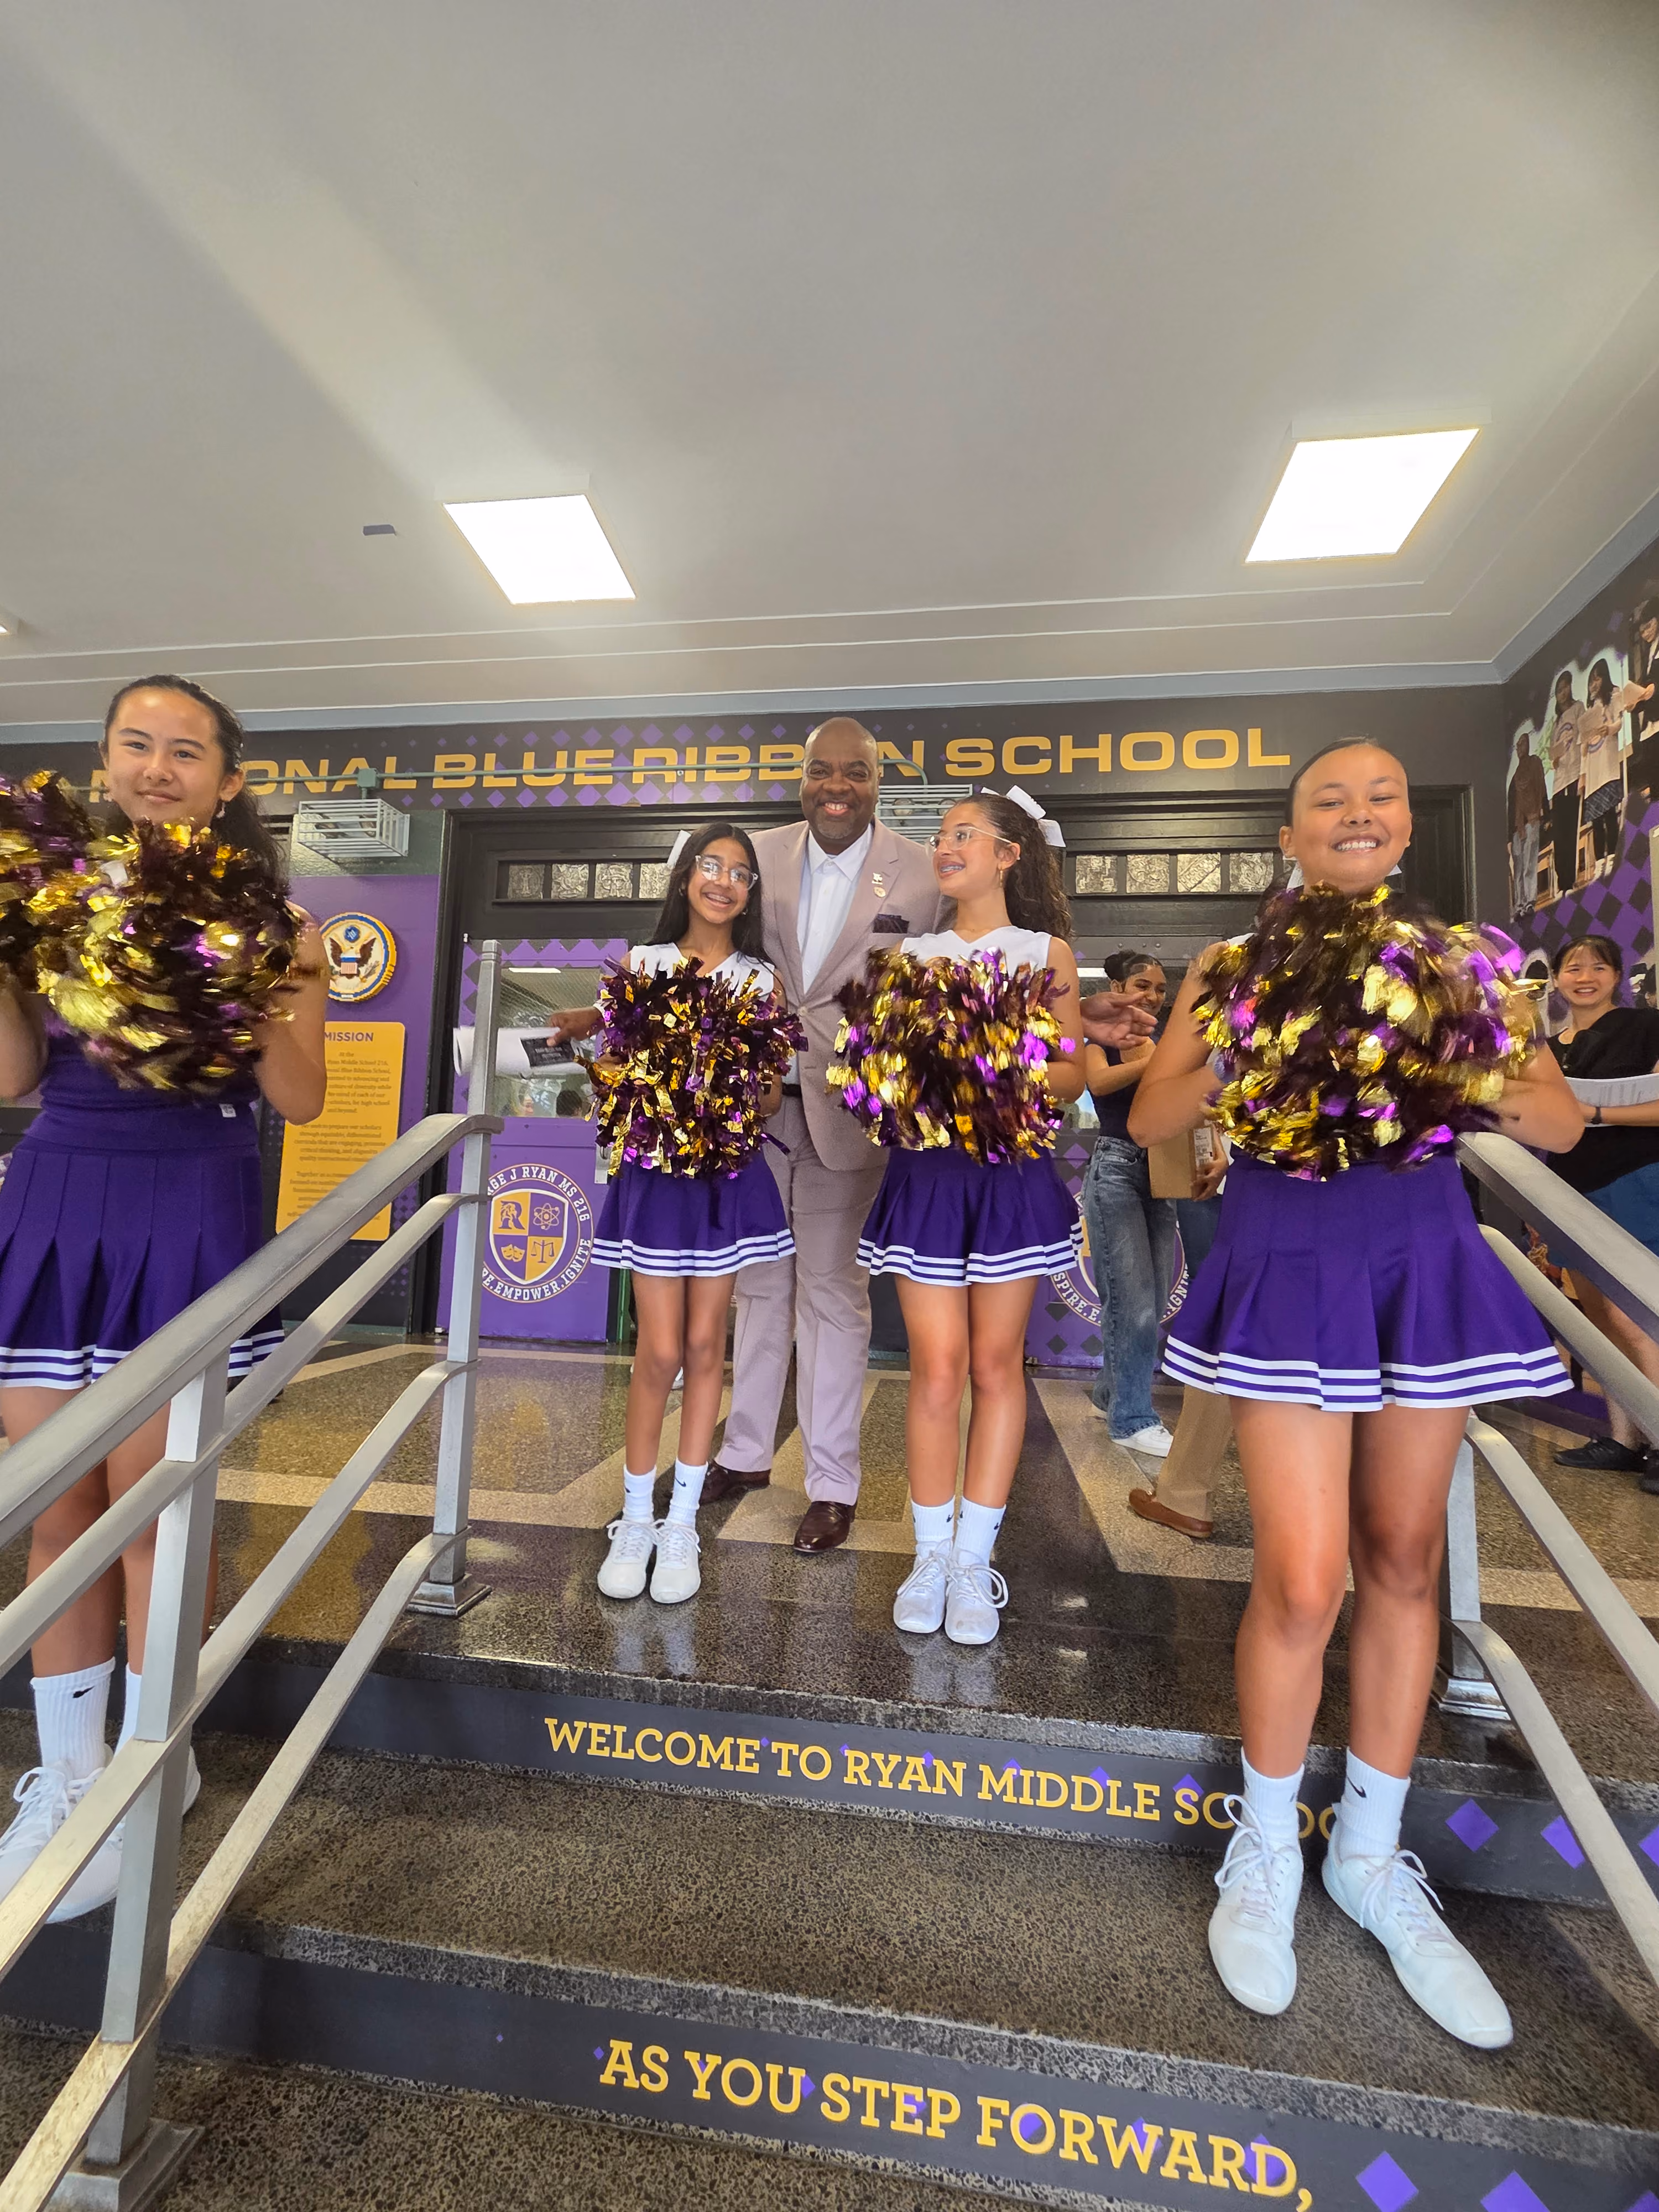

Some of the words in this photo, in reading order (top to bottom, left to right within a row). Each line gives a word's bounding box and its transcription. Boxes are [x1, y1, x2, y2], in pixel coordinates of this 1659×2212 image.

[88, 756, 416, 803] ONAL
[432, 749, 614, 789] BLUE
[632, 740, 924, 784] RIBBN
[945, 728, 1291, 777] SCHOOL
[324, 1032, 374, 1042] MISSION
[510, 1168, 517, 1180] J
[522, 1166, 558, 1183] RYAN
[558, 1178, 577, 1197] MS
[573, 1198, 590, 1221] 216
[545, 1718, 760, 1773] WELCOME
[771, 1741, 832, 1781] TO
[843, 1750, 967, 1797] RYAN
[977, 1764, 1161, 1821] MIDDLE
[599, 2039, 669, 2093] AS
[684, 2050, 806, 2113] YOU
[821, 2072, 961, 2139] STEP
[976, 2095, 1313, 2212] FORWARD,
